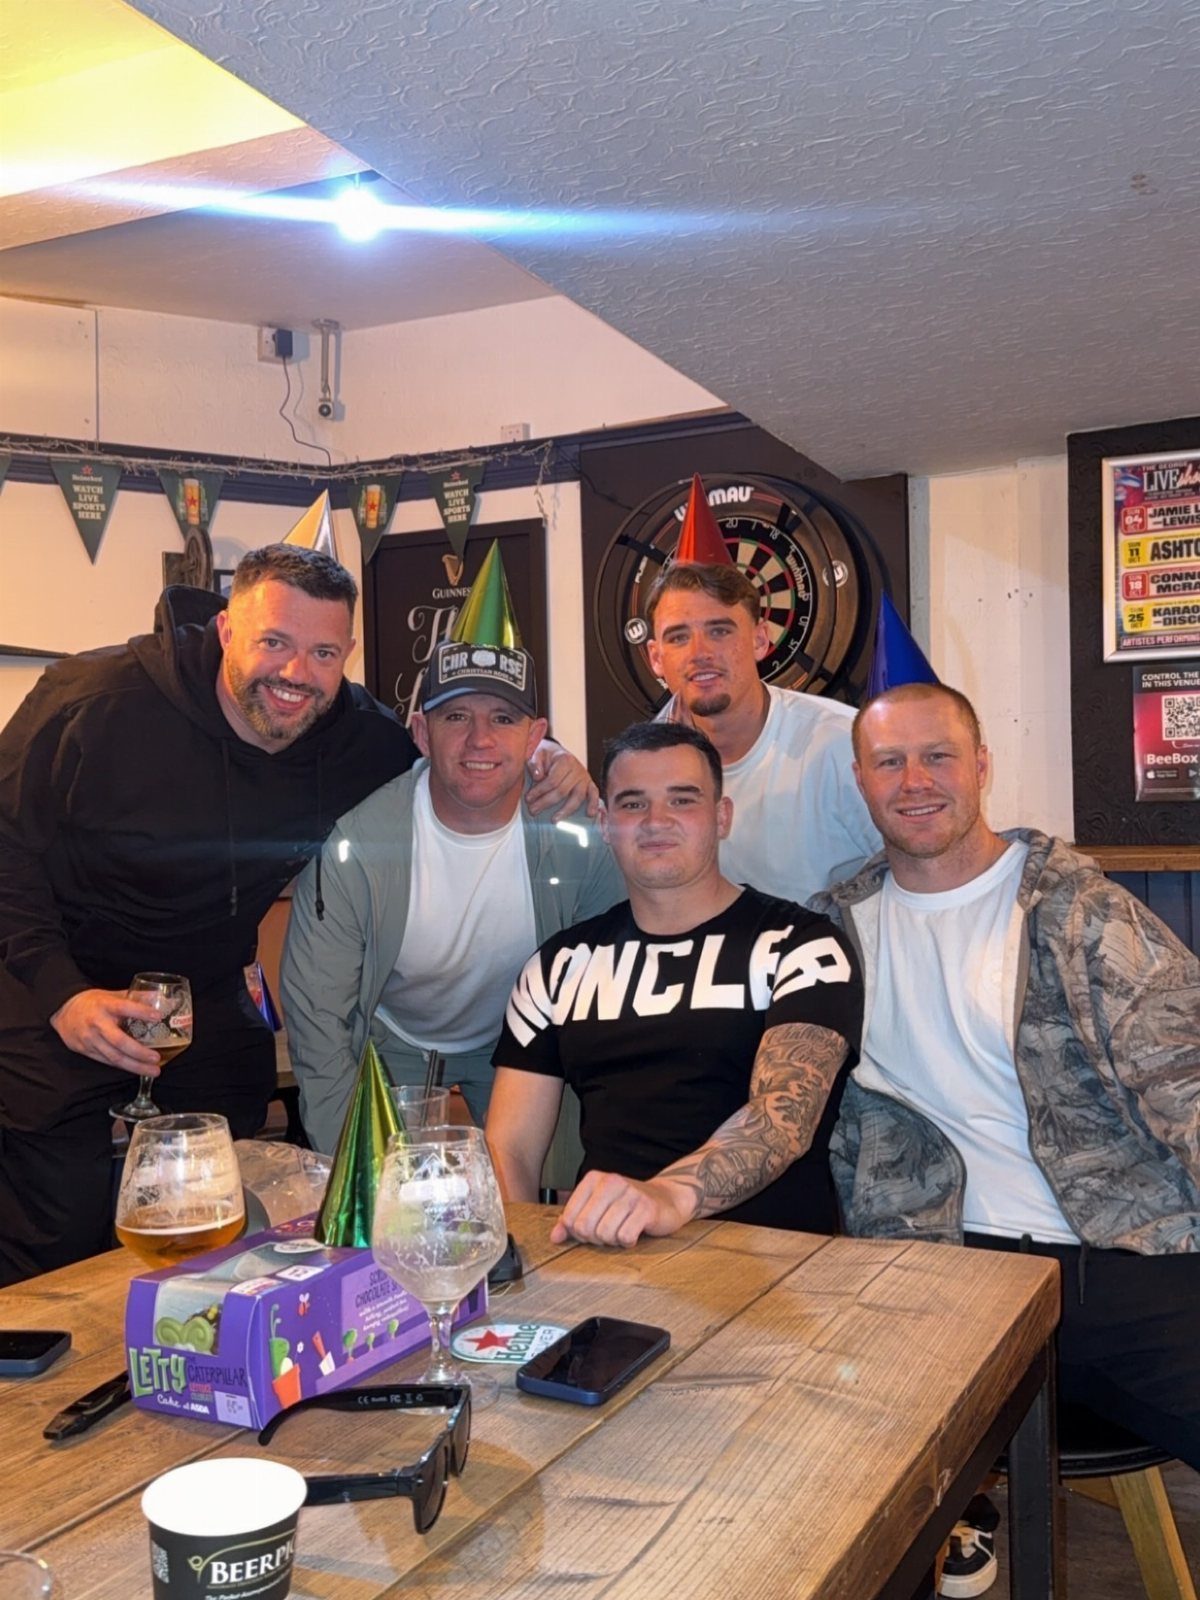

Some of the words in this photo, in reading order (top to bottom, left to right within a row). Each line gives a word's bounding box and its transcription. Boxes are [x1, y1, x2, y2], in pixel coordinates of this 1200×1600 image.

[1143, 468, 1180, 493] LIVE
[72, 484, 104, 495] WATCH
[444, 488, 469, 499] WATCH
[78, 494, 99, 503] LIVE
[448, 498, 466, 508] LIVE
[72, 502, 106, 512] SPORTS
[443, 505, 471, 515] SPORTS
[1149, 505, 1191, 518] JAMIE
[78, 511, 102, 520] HERE
[1125, 515, 1143, 525] 04
[1129, 548, 1140, 557] 11
[1128, 581, 1143, 590] 18
[432, 586, 473, 599] GUINNES
[1128, 613, 1145, 623] 25
[1142, 672, 1181, 682] CONTROL
[1183, 671, 1199, 680] THE
[1142, 680, 1152, 689] IN
[1154, 679, 1172, 688] THIS
[1173, 678, 1200, 687] VENUE
[1146, 752, 1199, 765] BeeBox
[129, 1347, 187, 1397] LETTY
[188, 1364, 249, 1387] CATERPILLAR
[190, 1402, 210, 1415] ASDA
